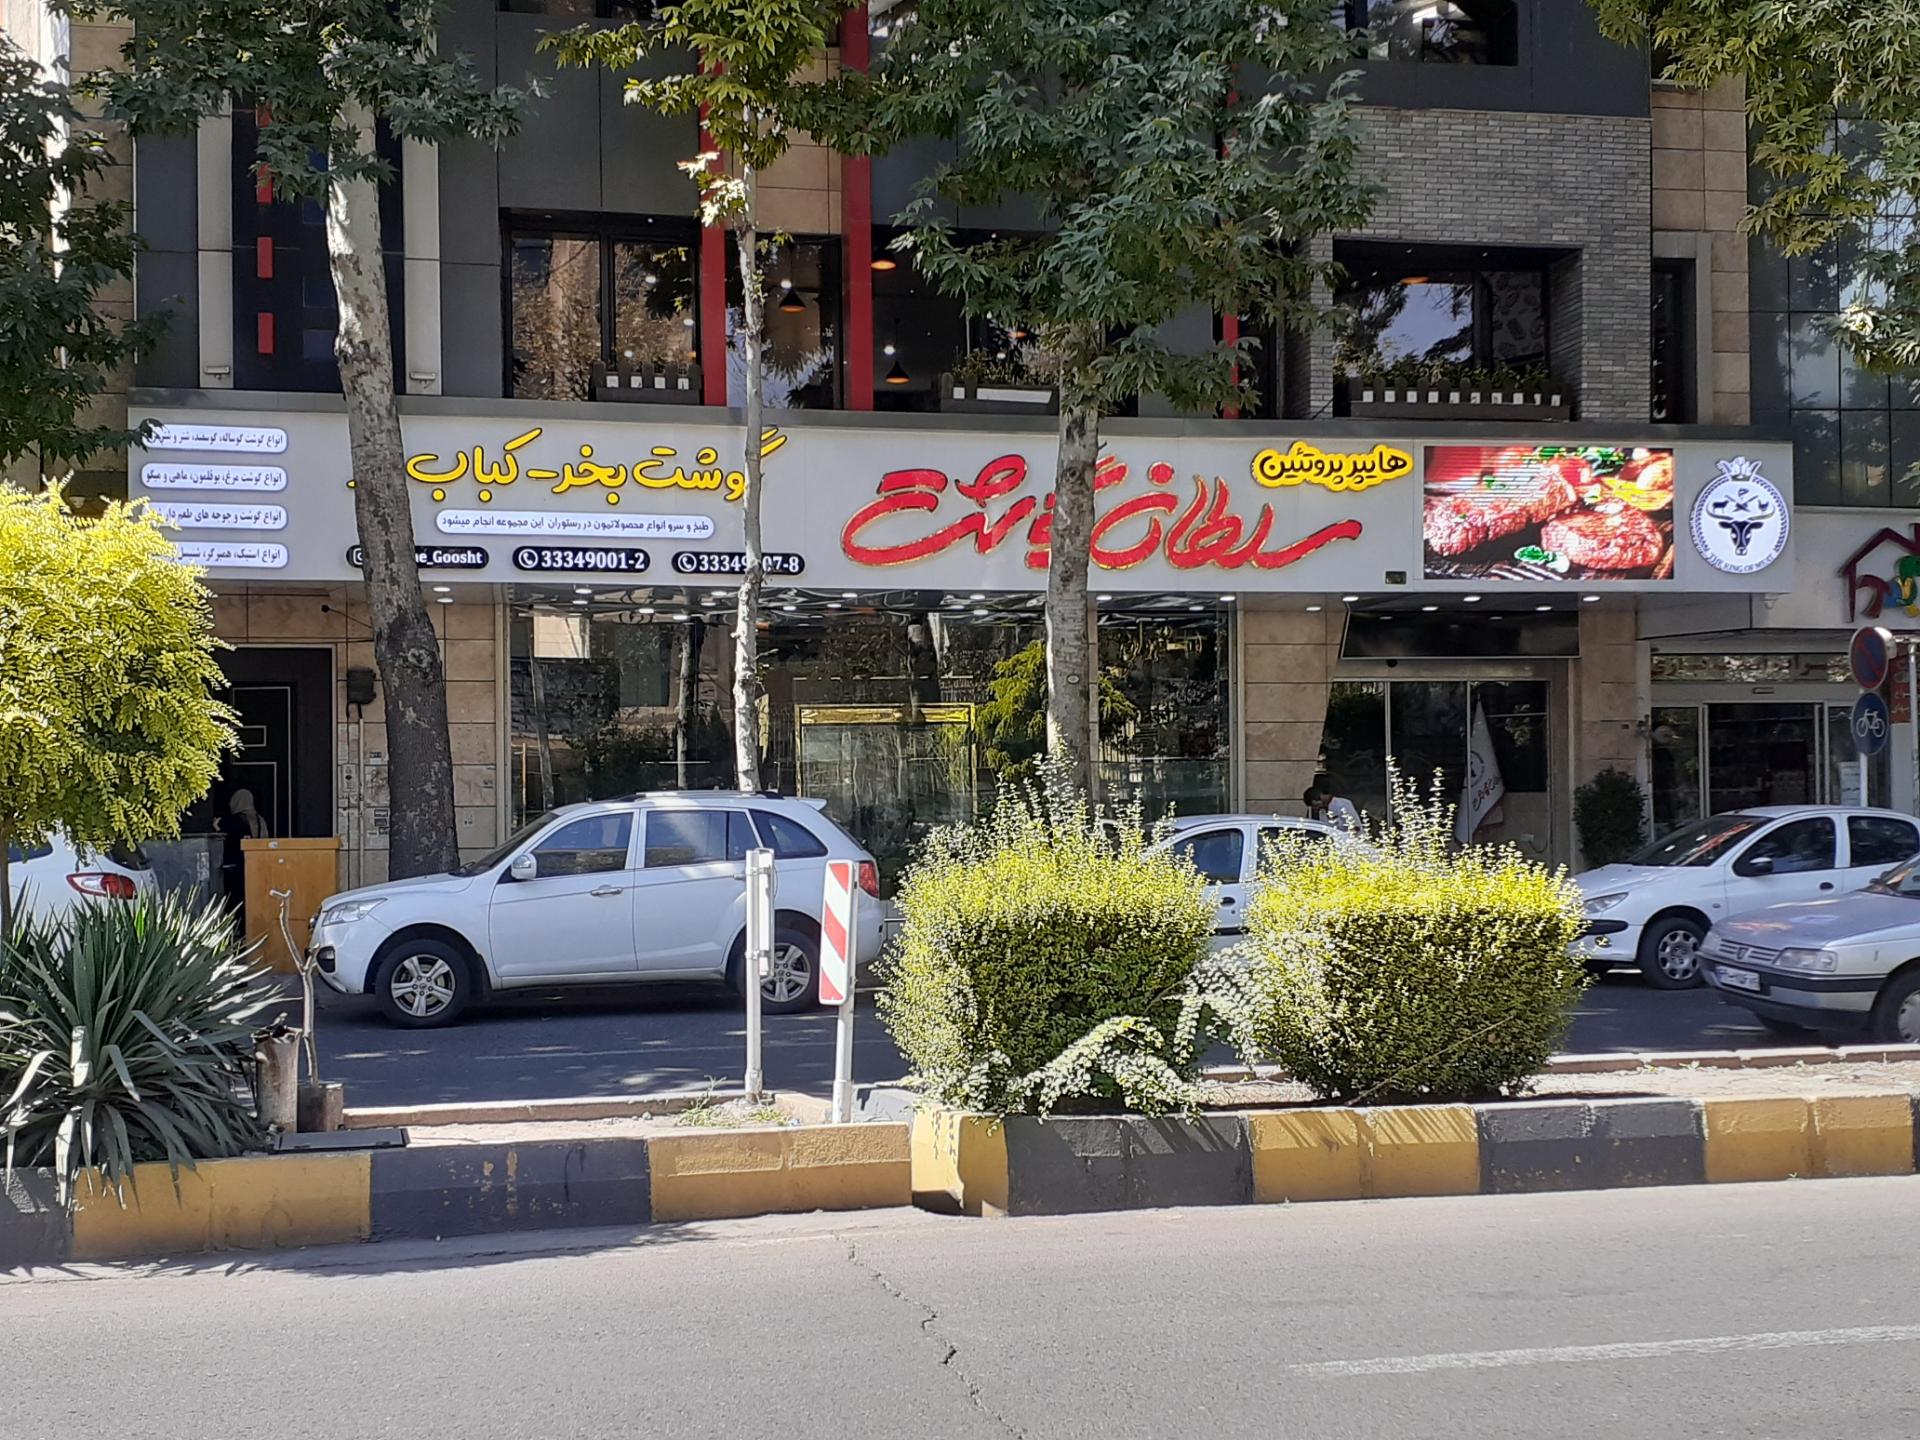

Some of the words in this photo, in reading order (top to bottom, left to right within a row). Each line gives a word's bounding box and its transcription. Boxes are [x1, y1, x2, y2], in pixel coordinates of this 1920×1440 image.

[245, 433, 265, 448] گوشت
[266, 434, 283, 447] انواع
[404, 427, 543, 504] کباب
[1259, 446, 1343, 485] پروتئین
[1347, 450, 1408, 484] هایپر
[146, 469, 162, 482] میگو
[168, 469, 188, 483] ماهی
[240, 472, 262, 486] گوشت
[263, 473, 282, 486] انواع
[178, 508, 193, 521] طعم
[194, 508, 210, 522] های
[211, 511, 232, 523] جوجه
[239, 510, 261, 524] گوشت
[263, 511, 282, 524] انواع
[442, 514, 470, 527] میشود
[472, 515, 494, 527] انجام
[1089, 461, 1363, 570] سلطان
[496, 518, 528, 528] مجموعه
[530, 517, 545, 529] این
[547, 518, 581, 530] رستوران
[646, 519, 666, 532] انواع
[667, 524, 684, 533] سرو
[693, 521, 709, 533] طبخ
[261, 550, 281, 562] انواع
[415, 550, 483, 565] e_Goosht
[541, 550, 645, 569] 33349001-2
[699, 554, 799, 572] 3334907-8
